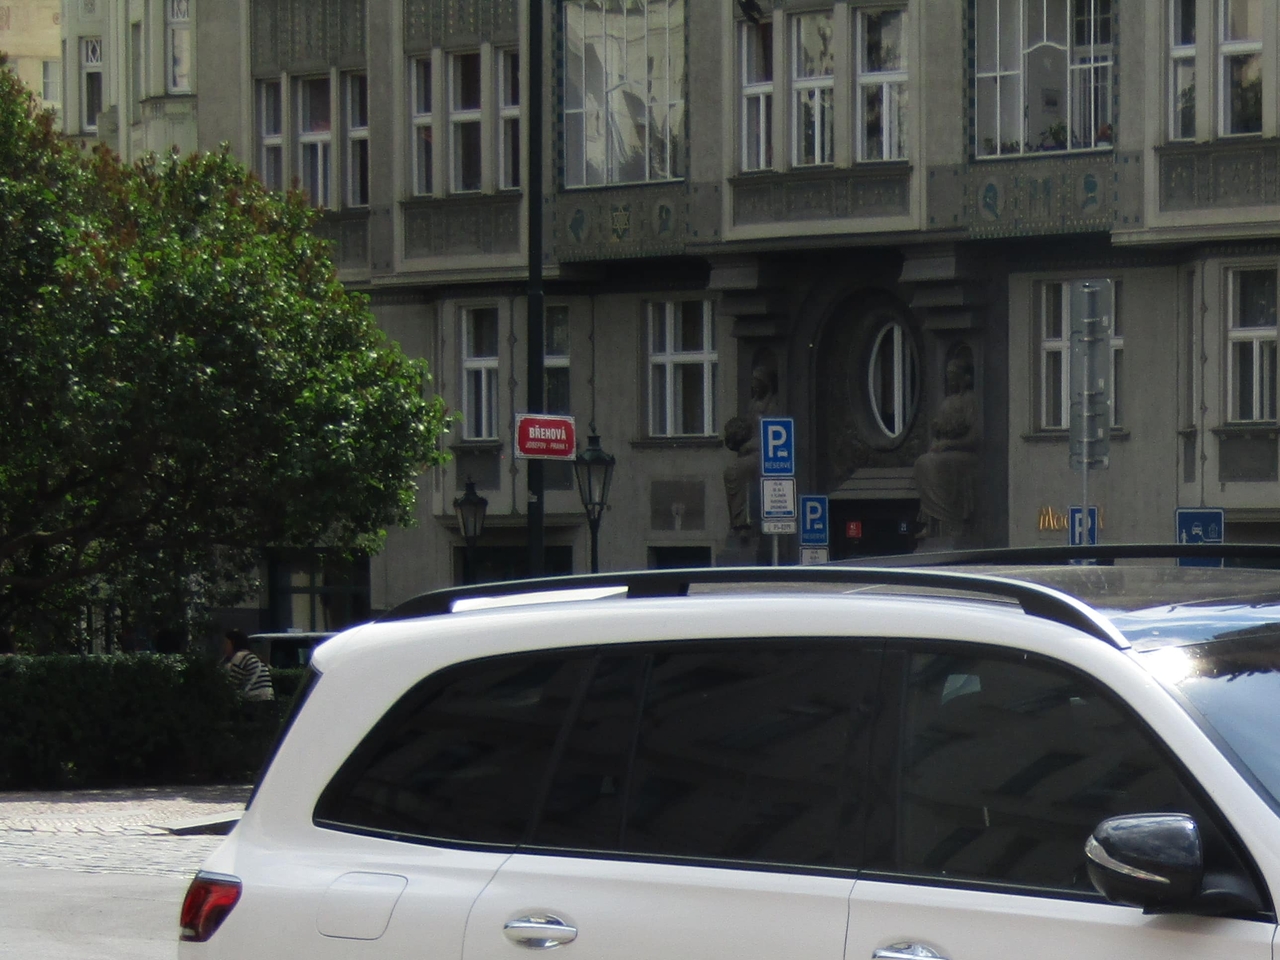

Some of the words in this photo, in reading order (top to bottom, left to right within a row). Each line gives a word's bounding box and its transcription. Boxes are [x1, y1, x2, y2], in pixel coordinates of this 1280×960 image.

[529, 424, 567, 440] BŘEHOVÁ
[768, 425, 787, 458] P
[806, 501, 823, 530] P
